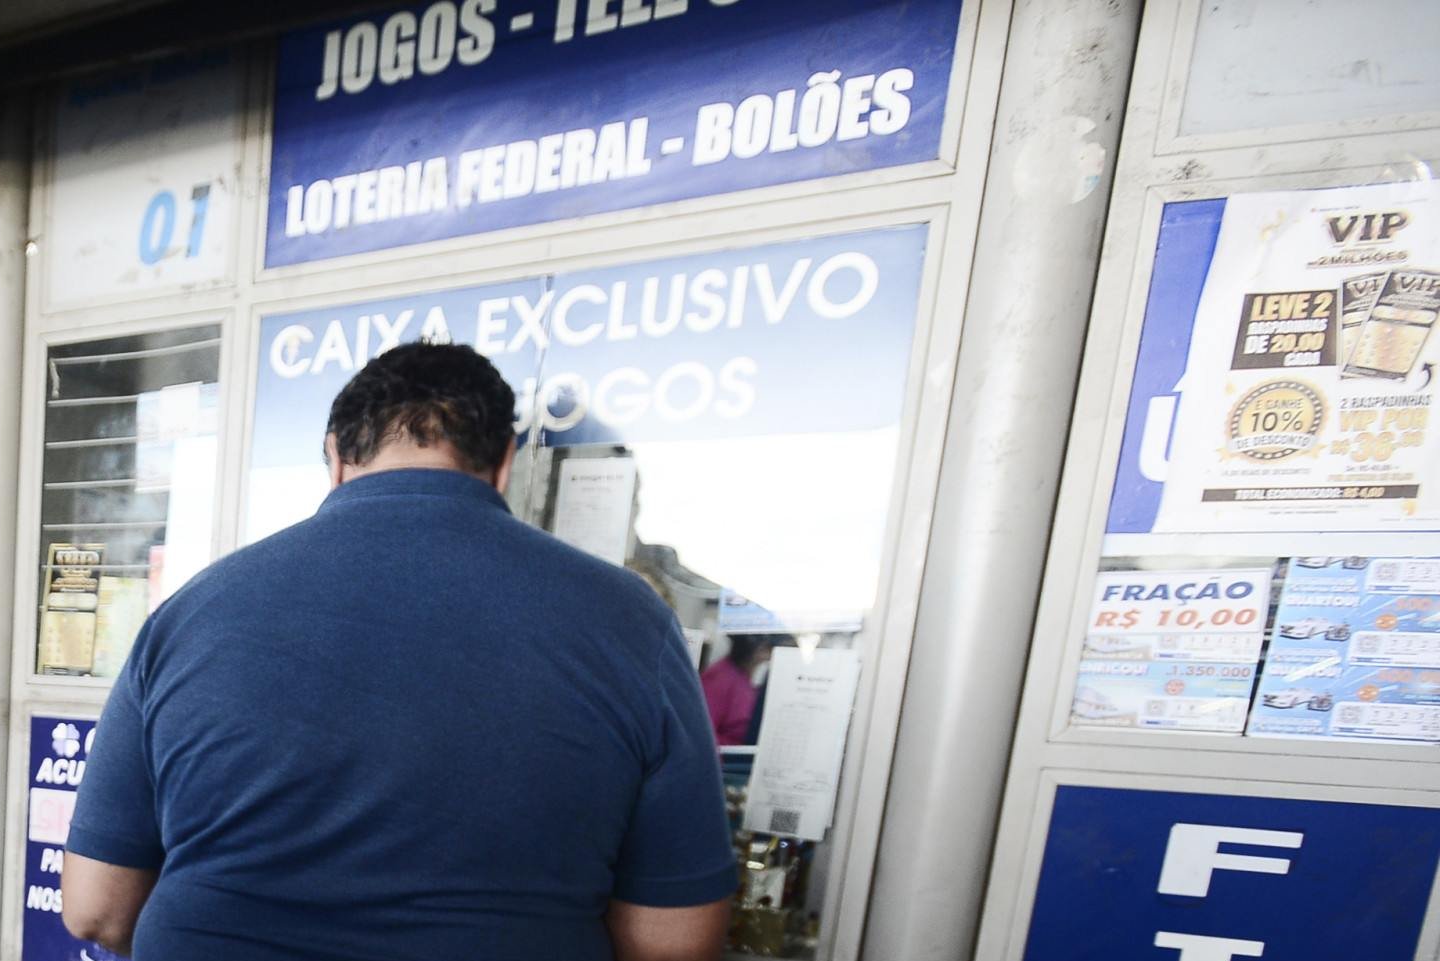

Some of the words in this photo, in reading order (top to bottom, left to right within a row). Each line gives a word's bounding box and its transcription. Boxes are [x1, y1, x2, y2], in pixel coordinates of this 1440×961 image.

[316, 0, 496, 100] JOGOS
[285, 157, 448, 236] LOTERIA
[456, 117, 651, 208] FEDERAL
[693, 68, 915, 167] BOLÕES
[139, 185, 211, 265] 01
[1328, 212, 1407, 244] VIP
[269, 306, 455, 379] CAIXA
[475, 251, 879, 357] EXCLUSIVO
[1251, 294, 1309, 320] LEVE
[1311, 292, 1334, 318] 2
[1243, 335, 1269, 354] DE
[1269, 333, 1326, 353] 20,00
[513, 356, 758, 434] JOGOS
[1252, 411, 1304, 433] 10%
[1254, 433, 1311, 448] DESCONTO
[1102, 576, 1254, 605] FRAÇÃO
[1095, 608, 1142, 629] R$
[1157, 608, 1258, 630] 10,00
